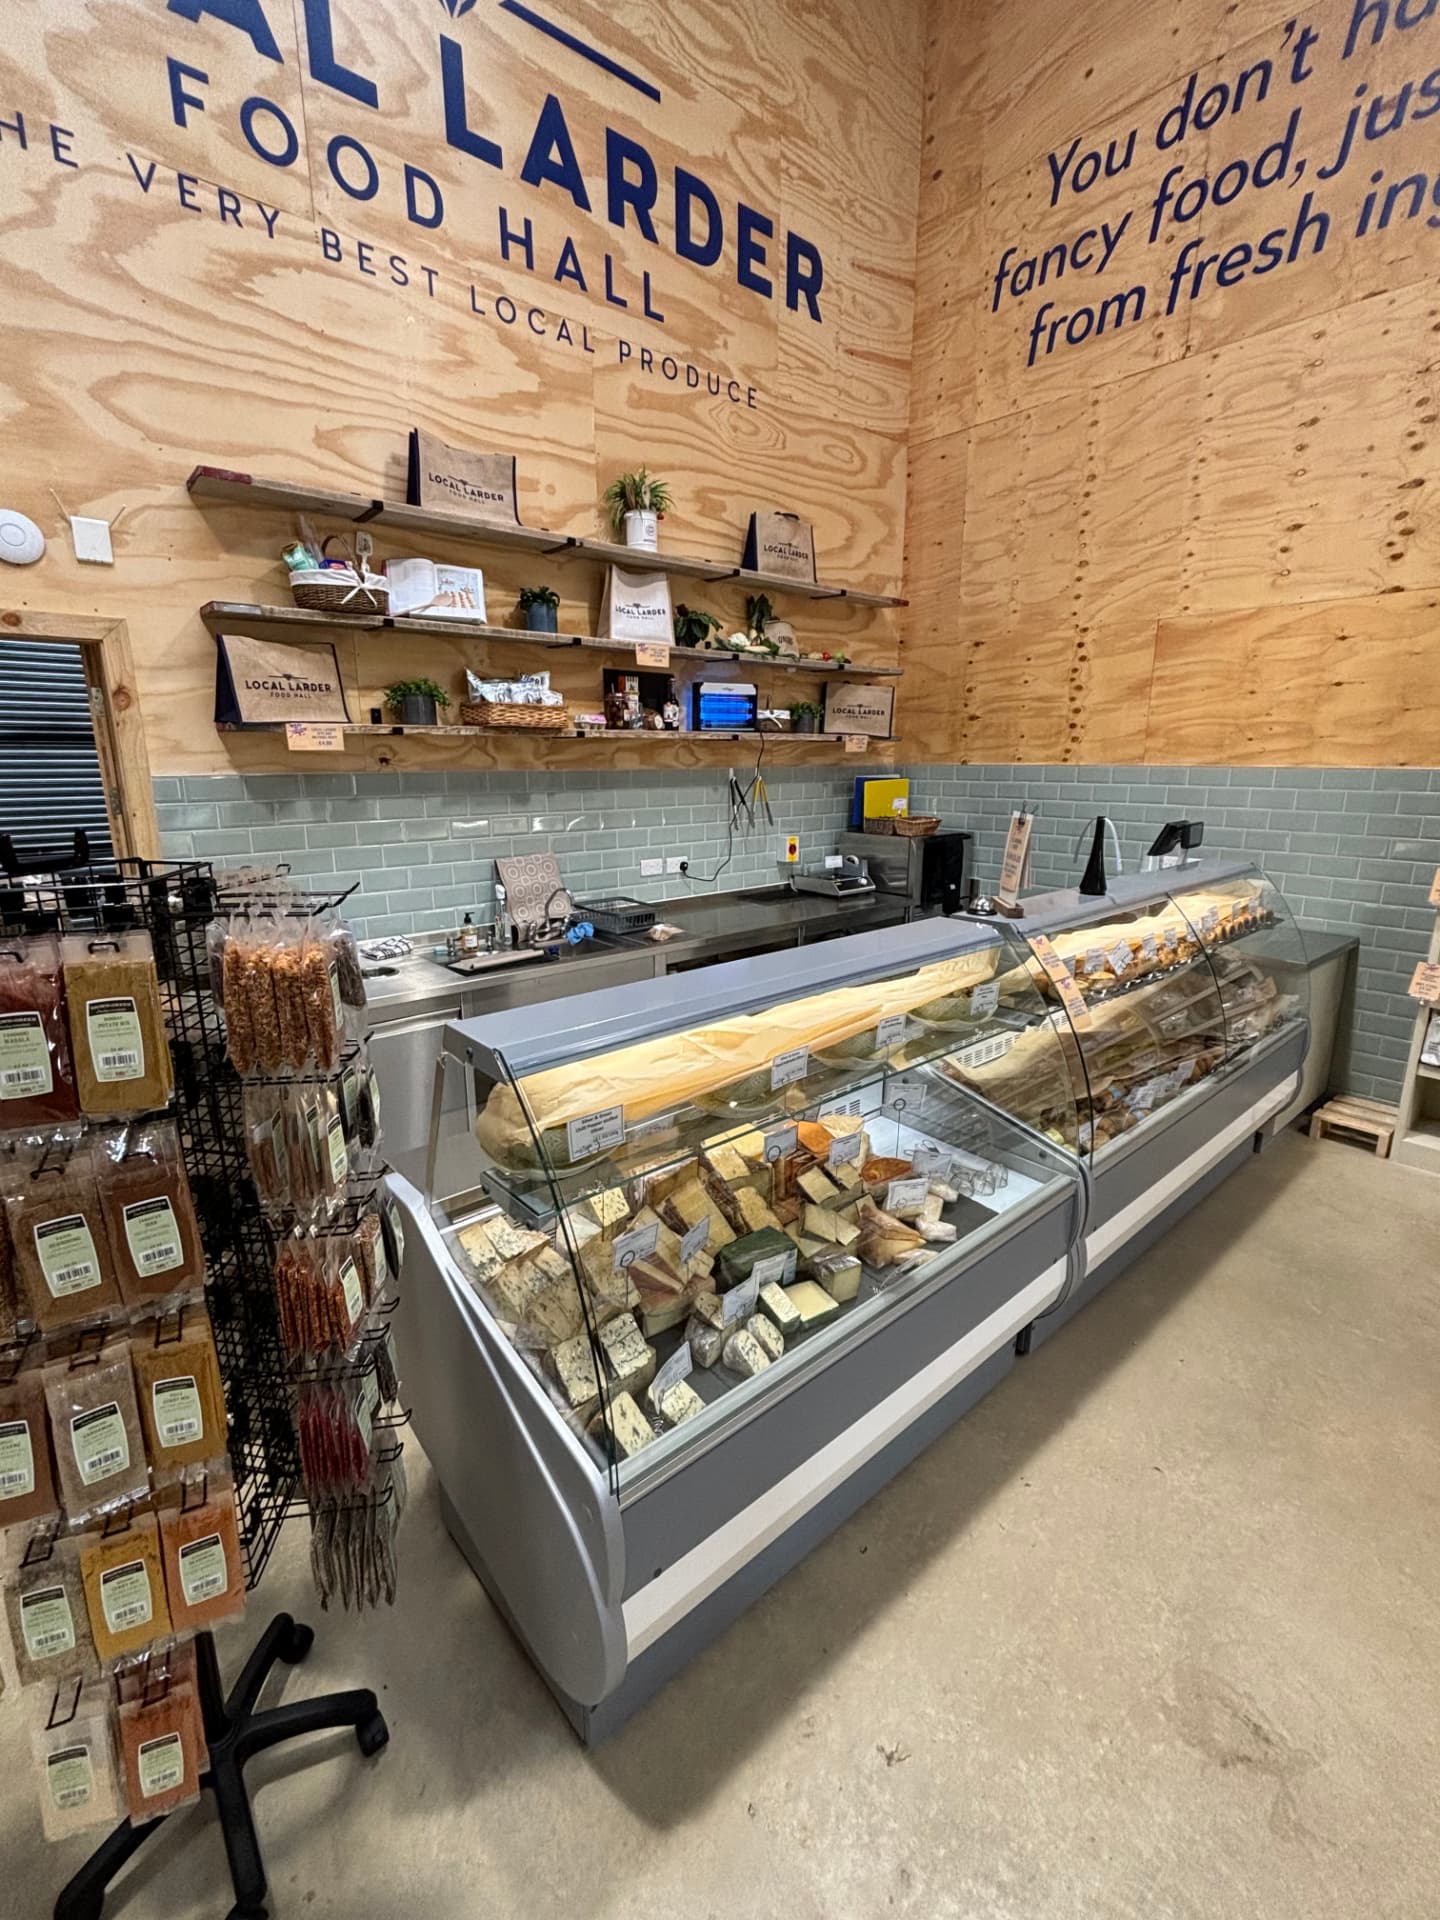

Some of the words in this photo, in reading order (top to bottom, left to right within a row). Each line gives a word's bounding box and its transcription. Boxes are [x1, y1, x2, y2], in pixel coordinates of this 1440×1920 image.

[167, 56, 444, 229] FOOD
[499, 206, 664, 323] HALL
[440, 33, 823, 324] LARDER
[1047, 130, 1138, 207] You
[1156, 19, 1319, 150] don't
[127, 152, 280, 239] VERY
[320, 228, 439, 297] BEST
[471, 284, 595, 353] LOCAL
[619, 340, 758, 409] PRODUCE
[992, 211, 1133, 313] fancy
[1148, 107, 1307, 243] food,
[1027, 284, 1146, 367] from
[1166, 191, 1331, 316] fresh
[428, 472, 460, 492] LOCAL
[463, 484, 504, 502] LARDER
[764, 544, 787, 554] LOCAL
[245, 680, 285, 690] LOCAL
[288, 682, 331, 692] LARDER
[615, 605, 635, 615] LOCAL
[832, 707, 856, 715] LOCAL
[858, 707, 885, 716] LARDER
